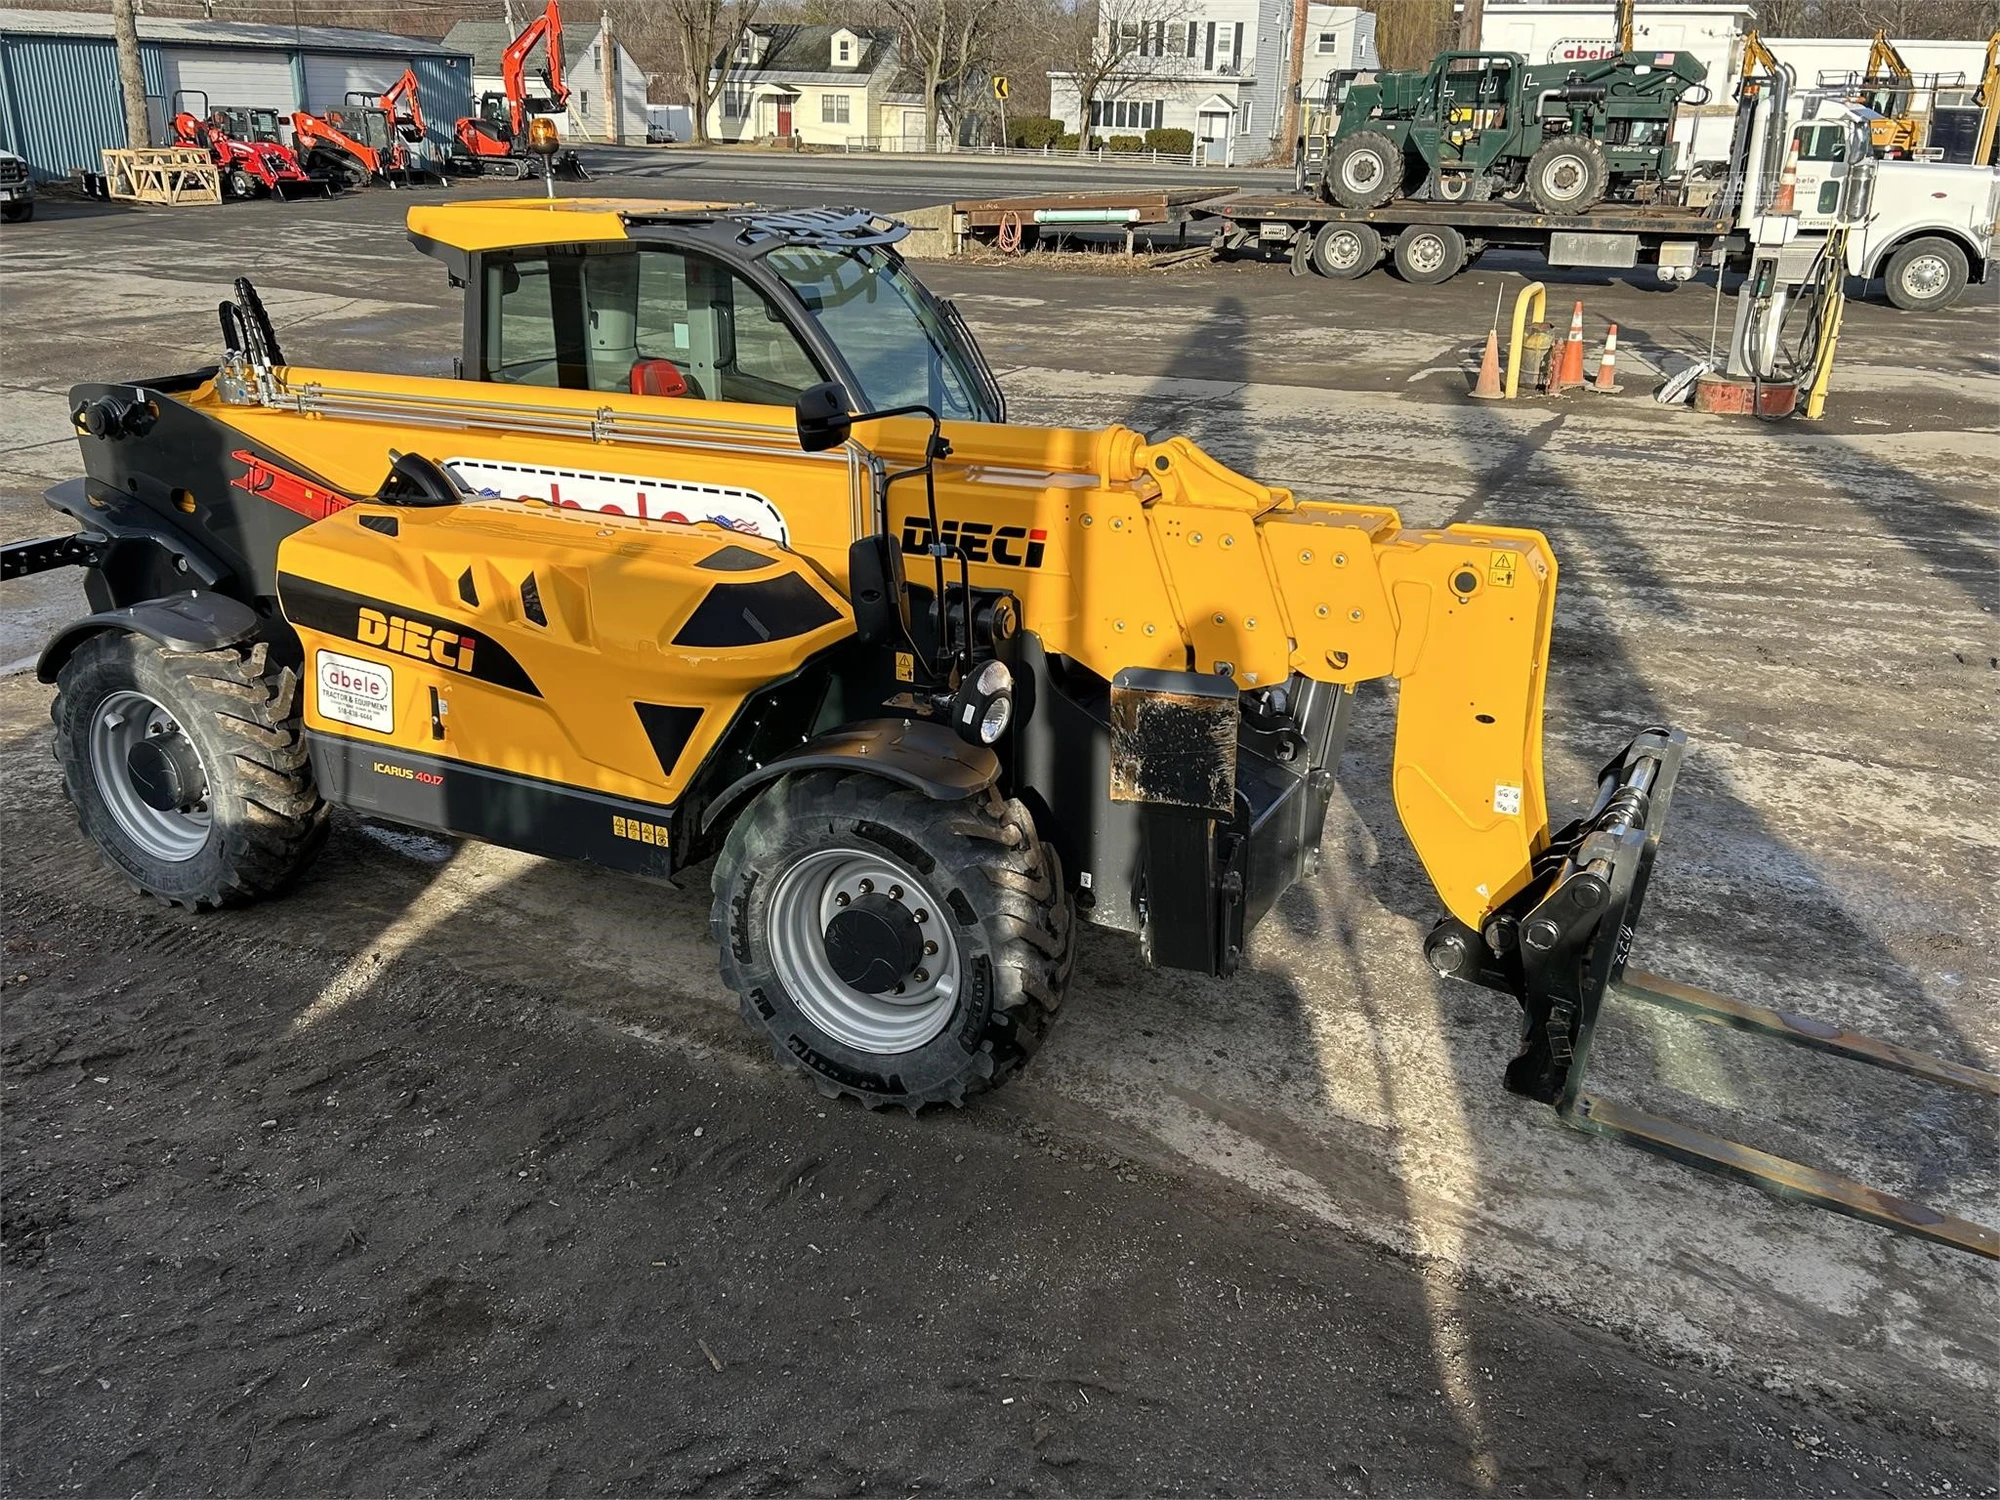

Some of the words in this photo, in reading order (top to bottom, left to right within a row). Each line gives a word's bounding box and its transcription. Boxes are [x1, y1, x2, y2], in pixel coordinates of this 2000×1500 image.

[1796, 176, 1816, 184] bele
[357, 606, 476, 673] DIECI
[329, 670, 380, 695] abele
[322, 688, 349, 703] TRACTOR
[354, 697, 388, 712] EQUIPMENT
[373, 762, 414, 780] ICARUS
[415, 772, 444, 785] 40.17
